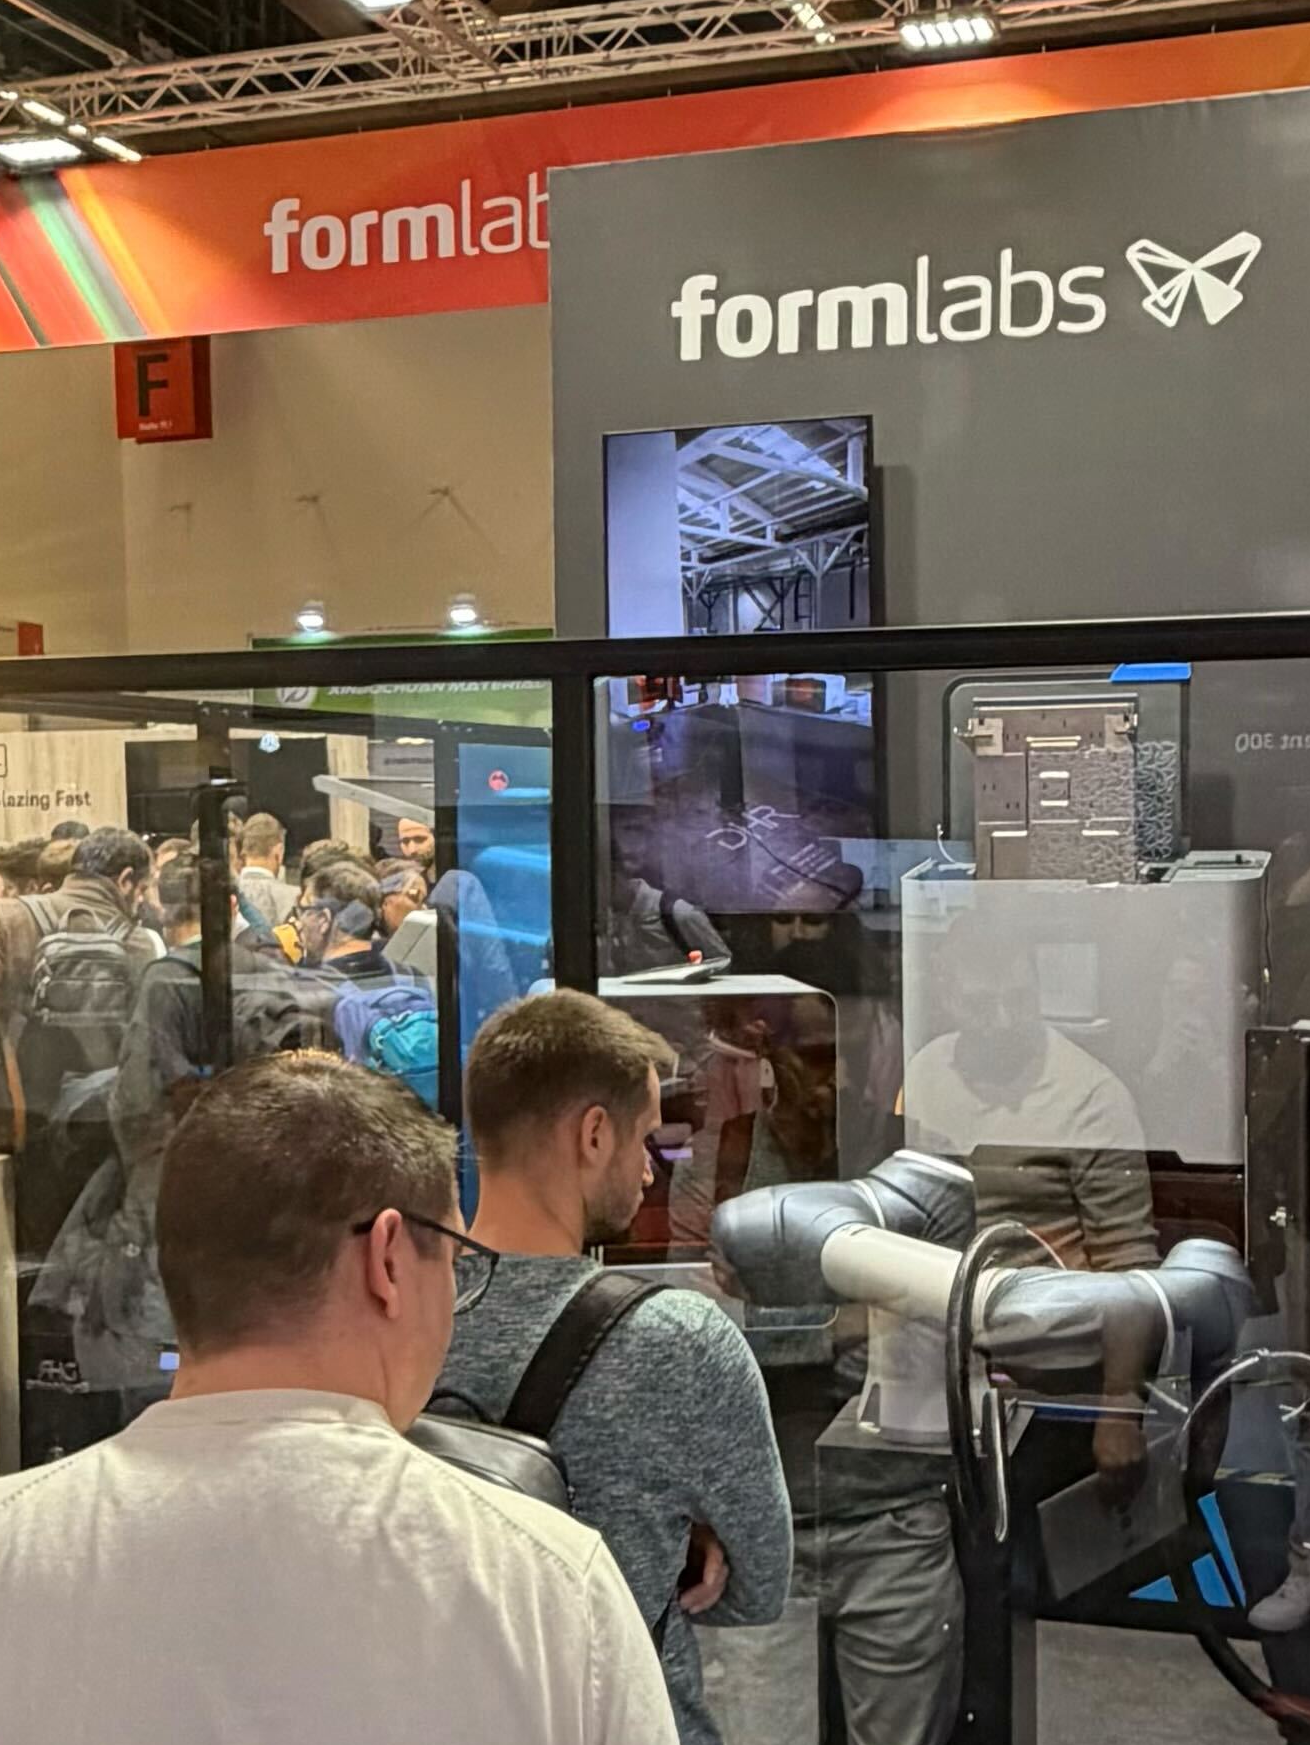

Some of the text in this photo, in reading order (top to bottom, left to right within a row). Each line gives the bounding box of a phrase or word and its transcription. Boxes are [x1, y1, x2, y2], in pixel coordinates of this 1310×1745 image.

[671, 248, 1107, 361] formlabs
[137, 352, 169, 417] F
[55, 789, 91, 807] Fast
